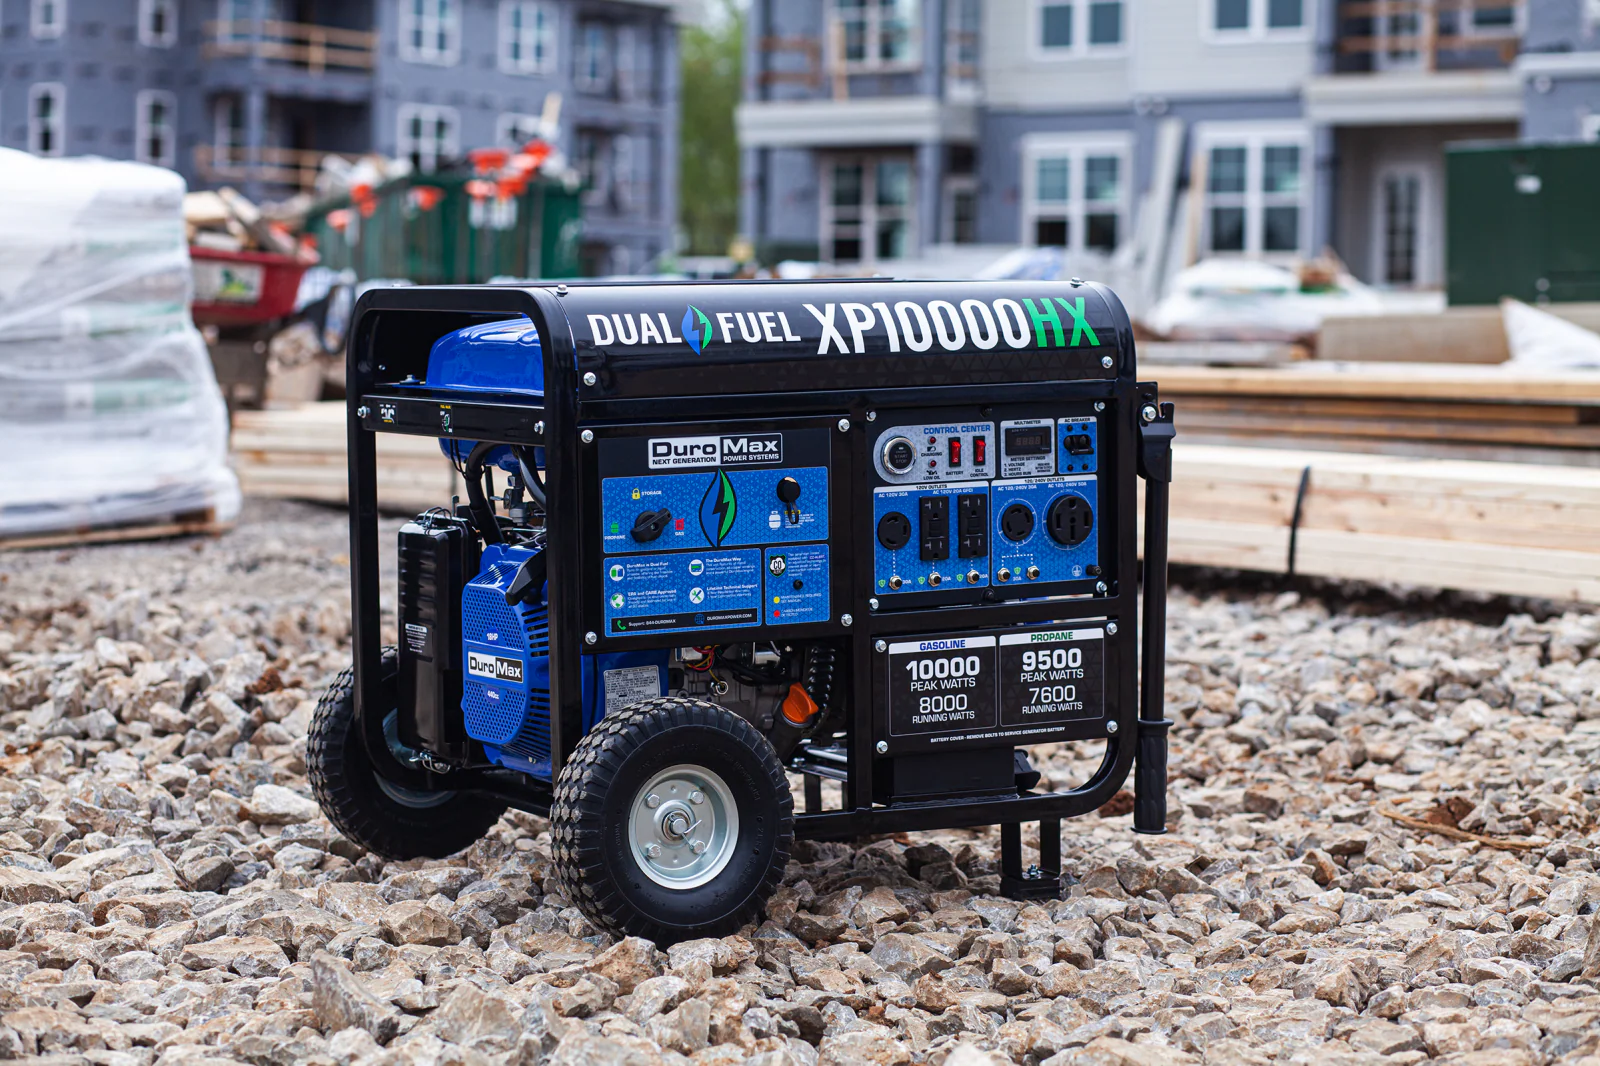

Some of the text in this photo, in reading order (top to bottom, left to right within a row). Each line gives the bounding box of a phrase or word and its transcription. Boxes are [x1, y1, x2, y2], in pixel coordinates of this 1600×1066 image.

[586, 297, 1100, 355] DUAL FUEL XP10000HX
[924, 424, 991, 434] CONTROL CENTER
[774, 560, 782, 569] CO
[1030, 632, 1074, 642] PROPANE
[920, 640, 966, 651] GASOLINE
[1022, 648, 1082, 672] 9500
[906, 656, 980, 681] 10000
[1020, 668, 1084, 683] PEAK WATTS
[910, 677, 976, 692] PEAK WATTS
[1028, 685, 1076, 705] 7600
[920, 694, 968, 714] 8000
[1022, 701, 1083, 714] RUNNING WATTS
[912, 711, 975, 724] RUNNING WATTS
